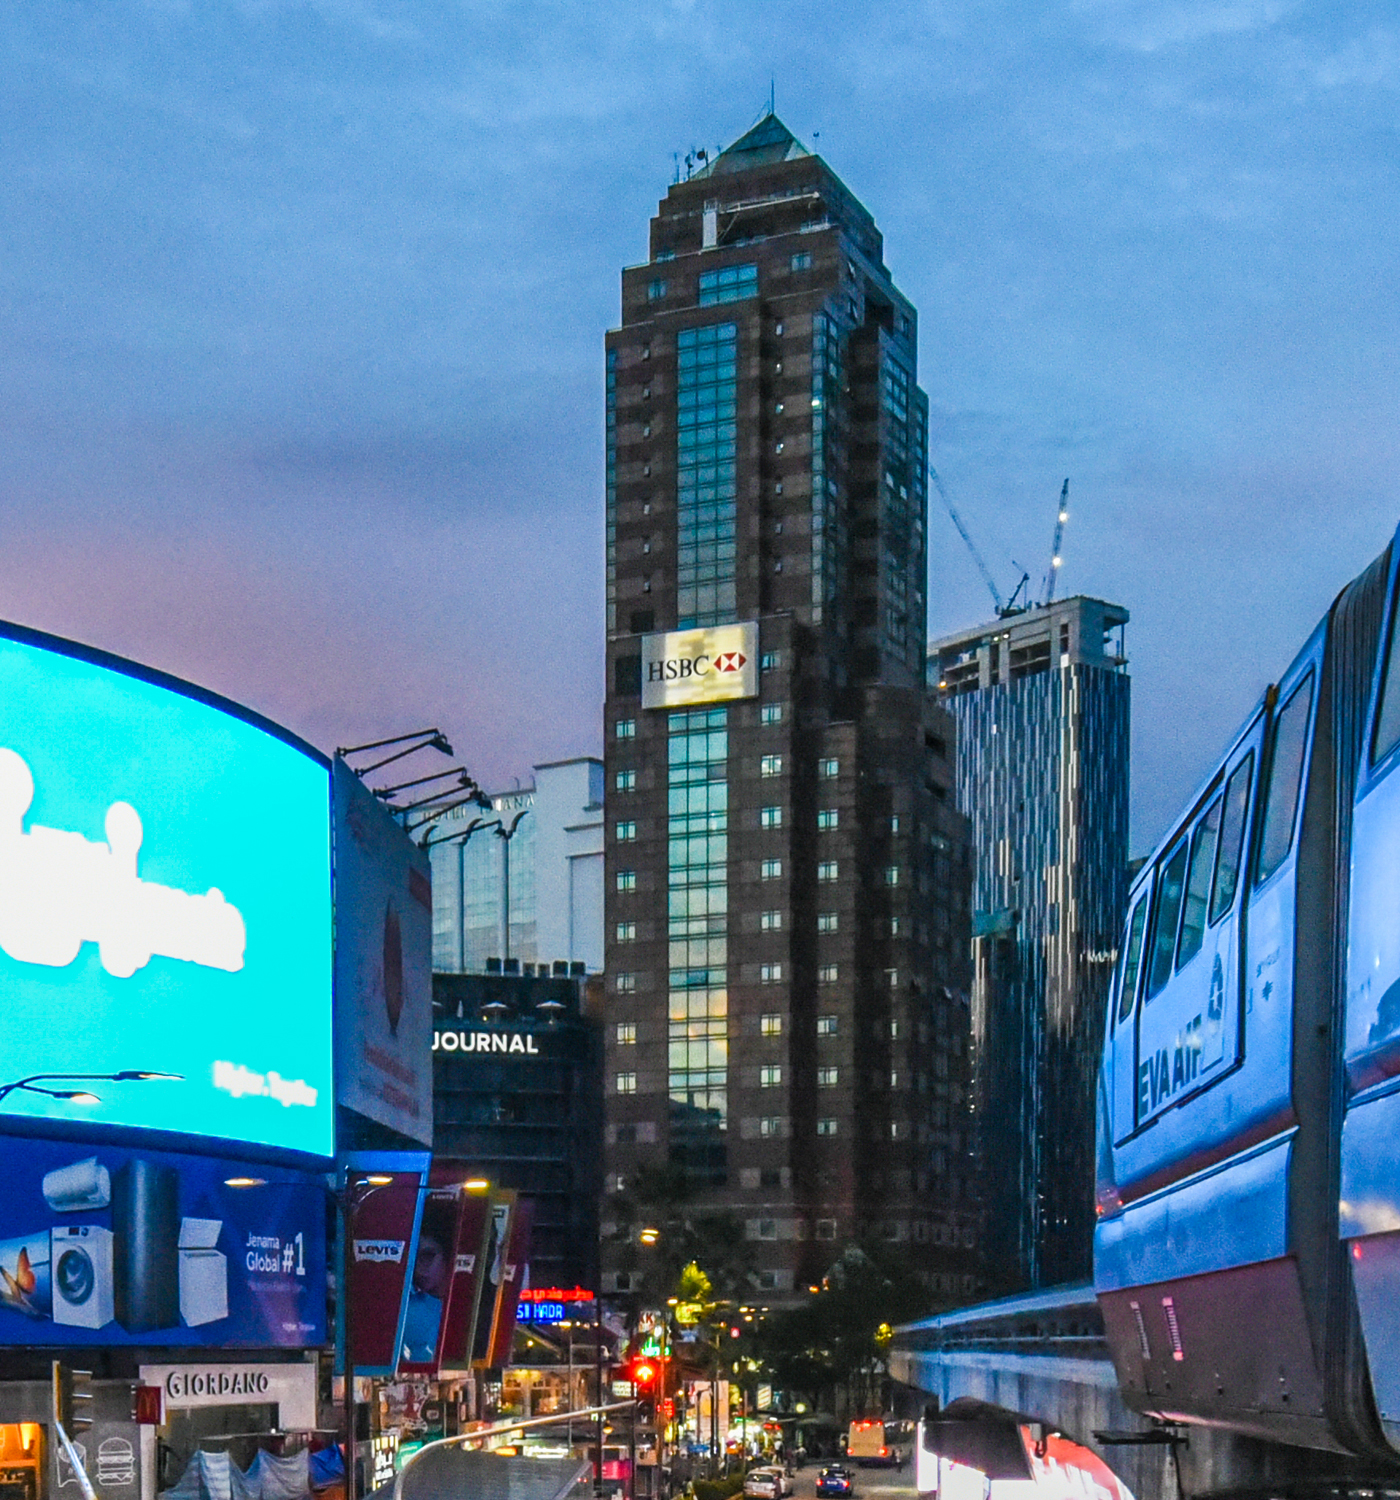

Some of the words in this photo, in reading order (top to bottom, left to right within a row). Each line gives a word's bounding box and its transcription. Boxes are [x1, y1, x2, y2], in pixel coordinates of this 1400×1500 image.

[647, 655, 710, 683] HSBC
[431, 1031, 539, 1055] JOURNAL
[245, 1231, 280, 1250] Jenama
[282, 1231, 306, 1276] #1
[245, 1250, 280, 1273] Global
[166, 1371, 271, 1400] GIORDANO
